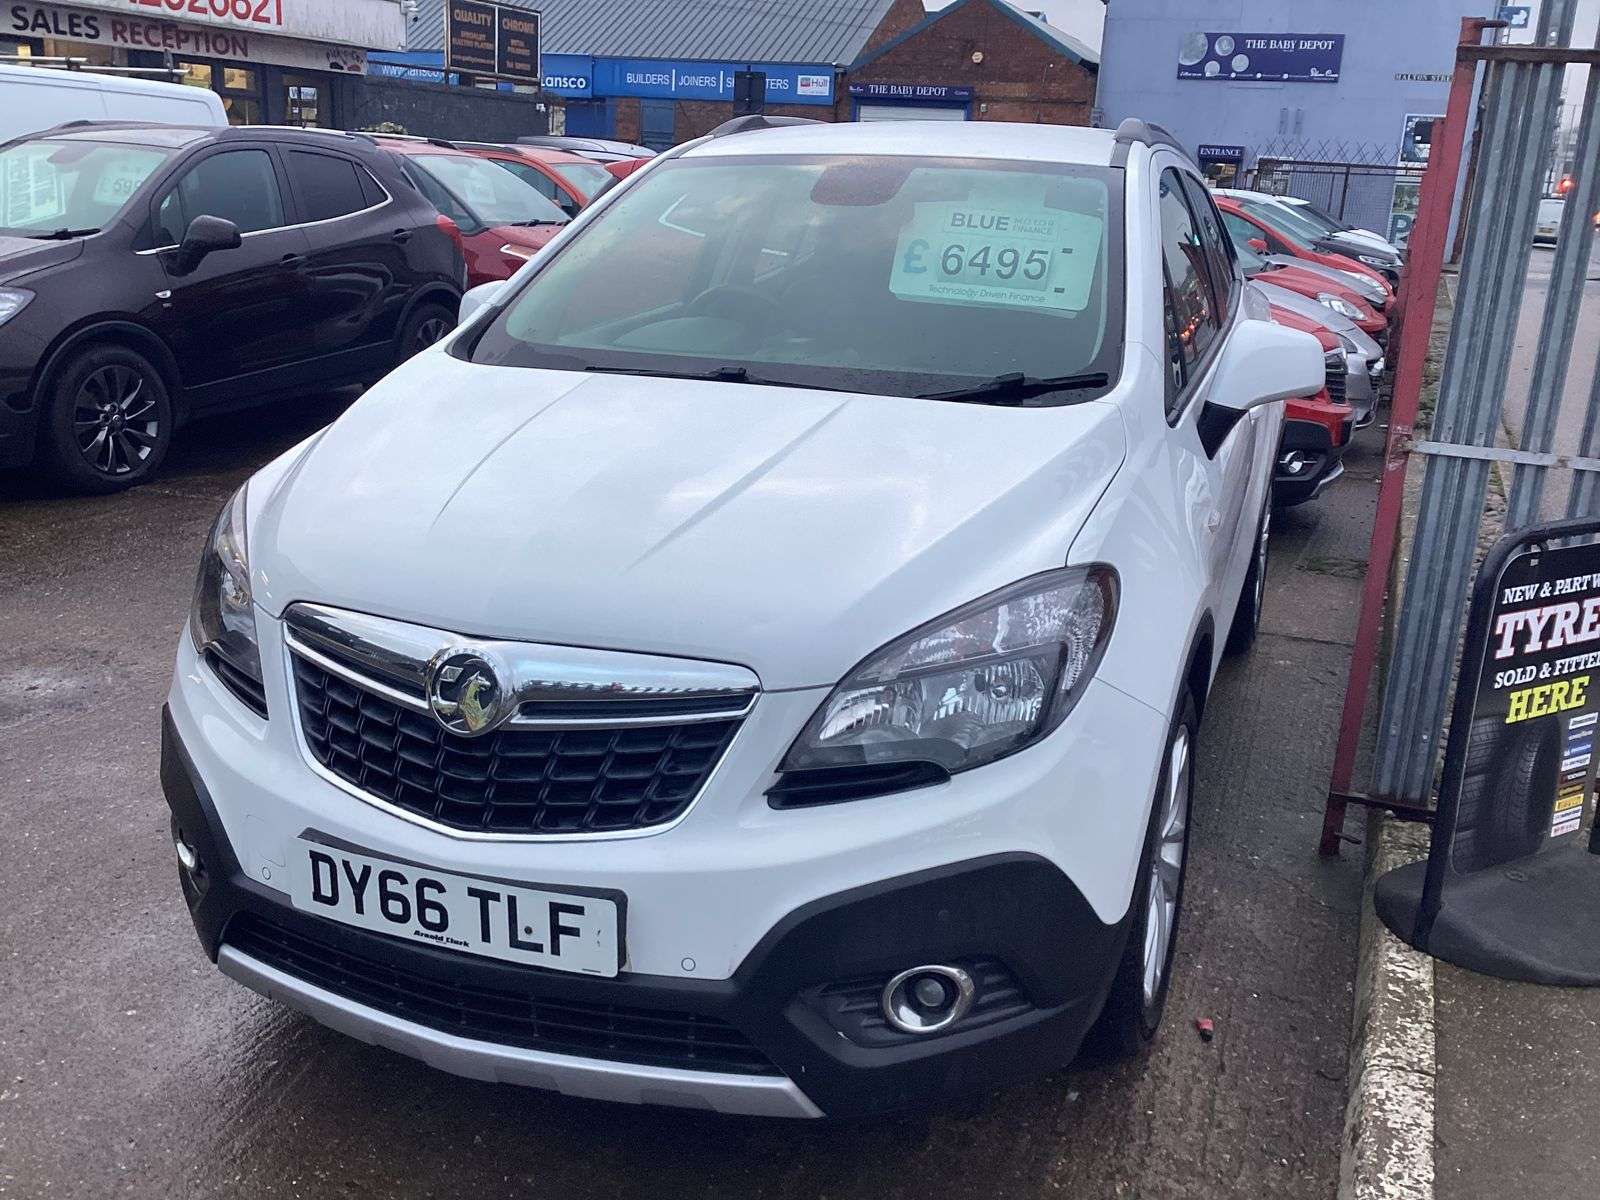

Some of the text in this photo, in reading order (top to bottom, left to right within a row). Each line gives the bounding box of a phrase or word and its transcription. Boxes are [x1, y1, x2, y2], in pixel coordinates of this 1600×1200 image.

[454, 9, 492, 26] QUALITY
[11, 5, 249, 57] SALES RECEPTION
[1246, 39, 1335, 50] THE BABY DEPOT
[626, 73, 670, 85] BUILDERS
[679, 75, 716, 87] JOINERS
[868, 84, 888, 94] THE
[890, 85, 914, 95] BABY
[916, 86, 948, 96] DEPOT
[1200, 147, 1241, 157] ENTRANCE
[950, 212, 1010, 231] BLUE
[941, 244, 1049, 280] 6495
[1502, 583, 1540, 605] NEW
[1540, 581, 1552, 597] &
[1554, 574, 1591, 596] PART
[1494, 665, 1537, 689] SOLD
[1539, 662, 1552, 679] &
[1504, 675, 1591, 725] HERE
[309, 849, 585, 957] DY66 TLF
